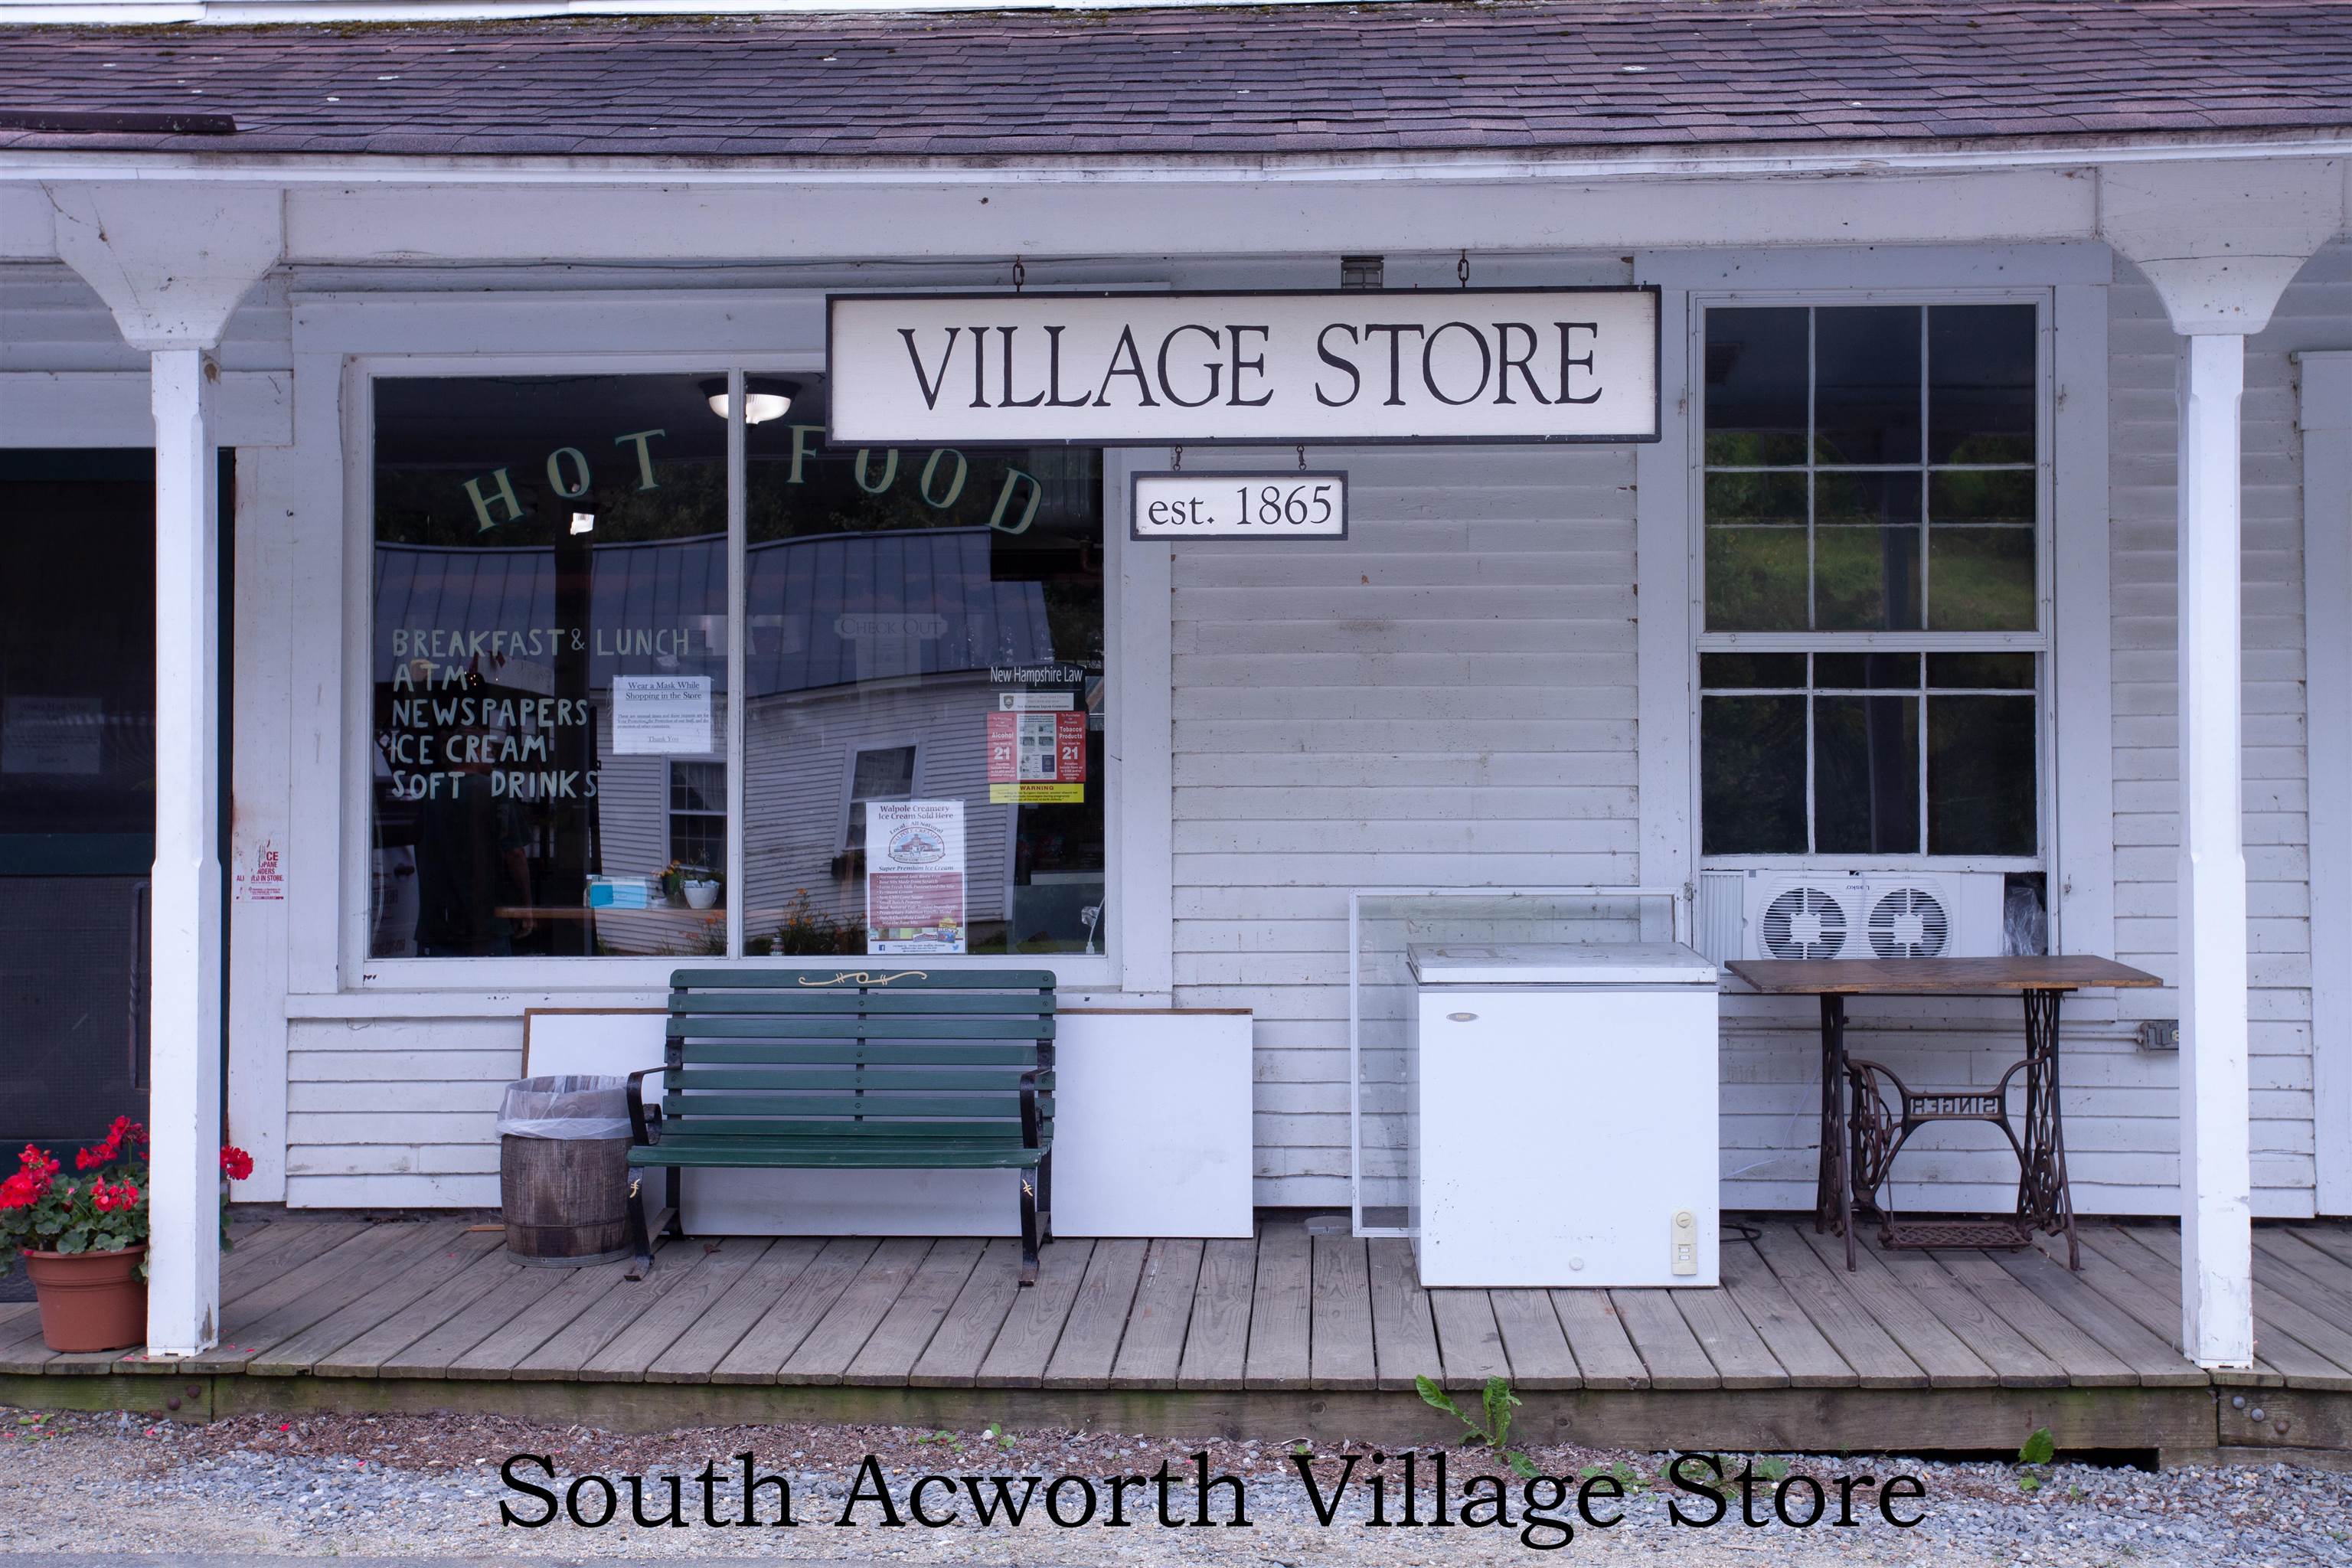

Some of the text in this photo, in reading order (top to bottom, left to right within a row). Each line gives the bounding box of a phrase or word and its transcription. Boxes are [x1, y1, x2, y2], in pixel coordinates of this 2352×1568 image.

[897, 322, 1602, 411] VILLAGE STORE
[462, 429, 665, 534] HOT
[1149, 485, 1331, 525] est. 1865
[393, 629, 690, 658] BREAKFAST & LUNCH
[393, 663, 467, 693] ATM
[990, 666, 1083, 687] New Hampshire Law
[626, 692, 659, 701] Shopping
[393, 697, 589, 728] NEWSPAPERS
[390, 733, 547, 765] ICE CREAM
[994, 746, 1010, 760] 21
[1062, 746, 1078, 760] 21
[392, 769, 599, 800] SOFT DRINKS
[920, 821, 944, 834] Natural
